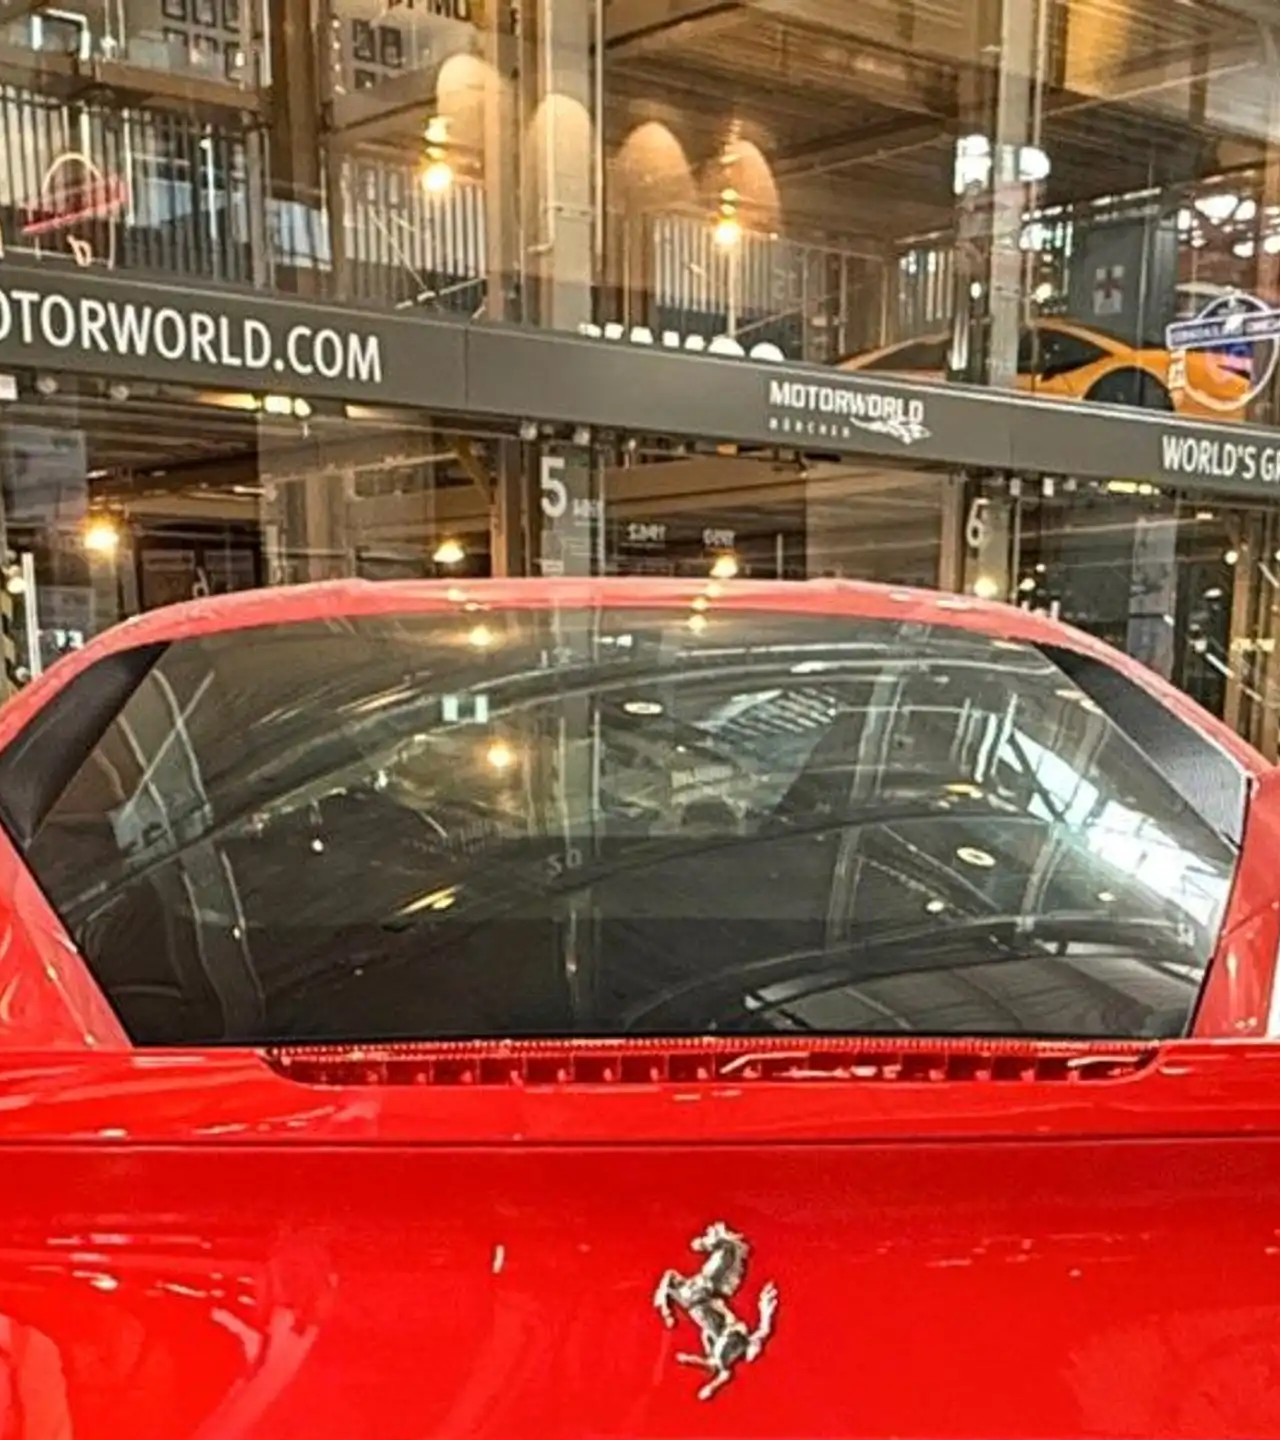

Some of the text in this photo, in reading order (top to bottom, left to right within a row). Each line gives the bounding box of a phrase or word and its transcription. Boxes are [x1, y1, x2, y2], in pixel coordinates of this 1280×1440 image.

[770, 379, 925, 425] MOTORWORLD
[1162, 434, 1258, 480] WORLD'S
[540, 456, 568, 518] 5
[965, 498, 990, 548] 6
